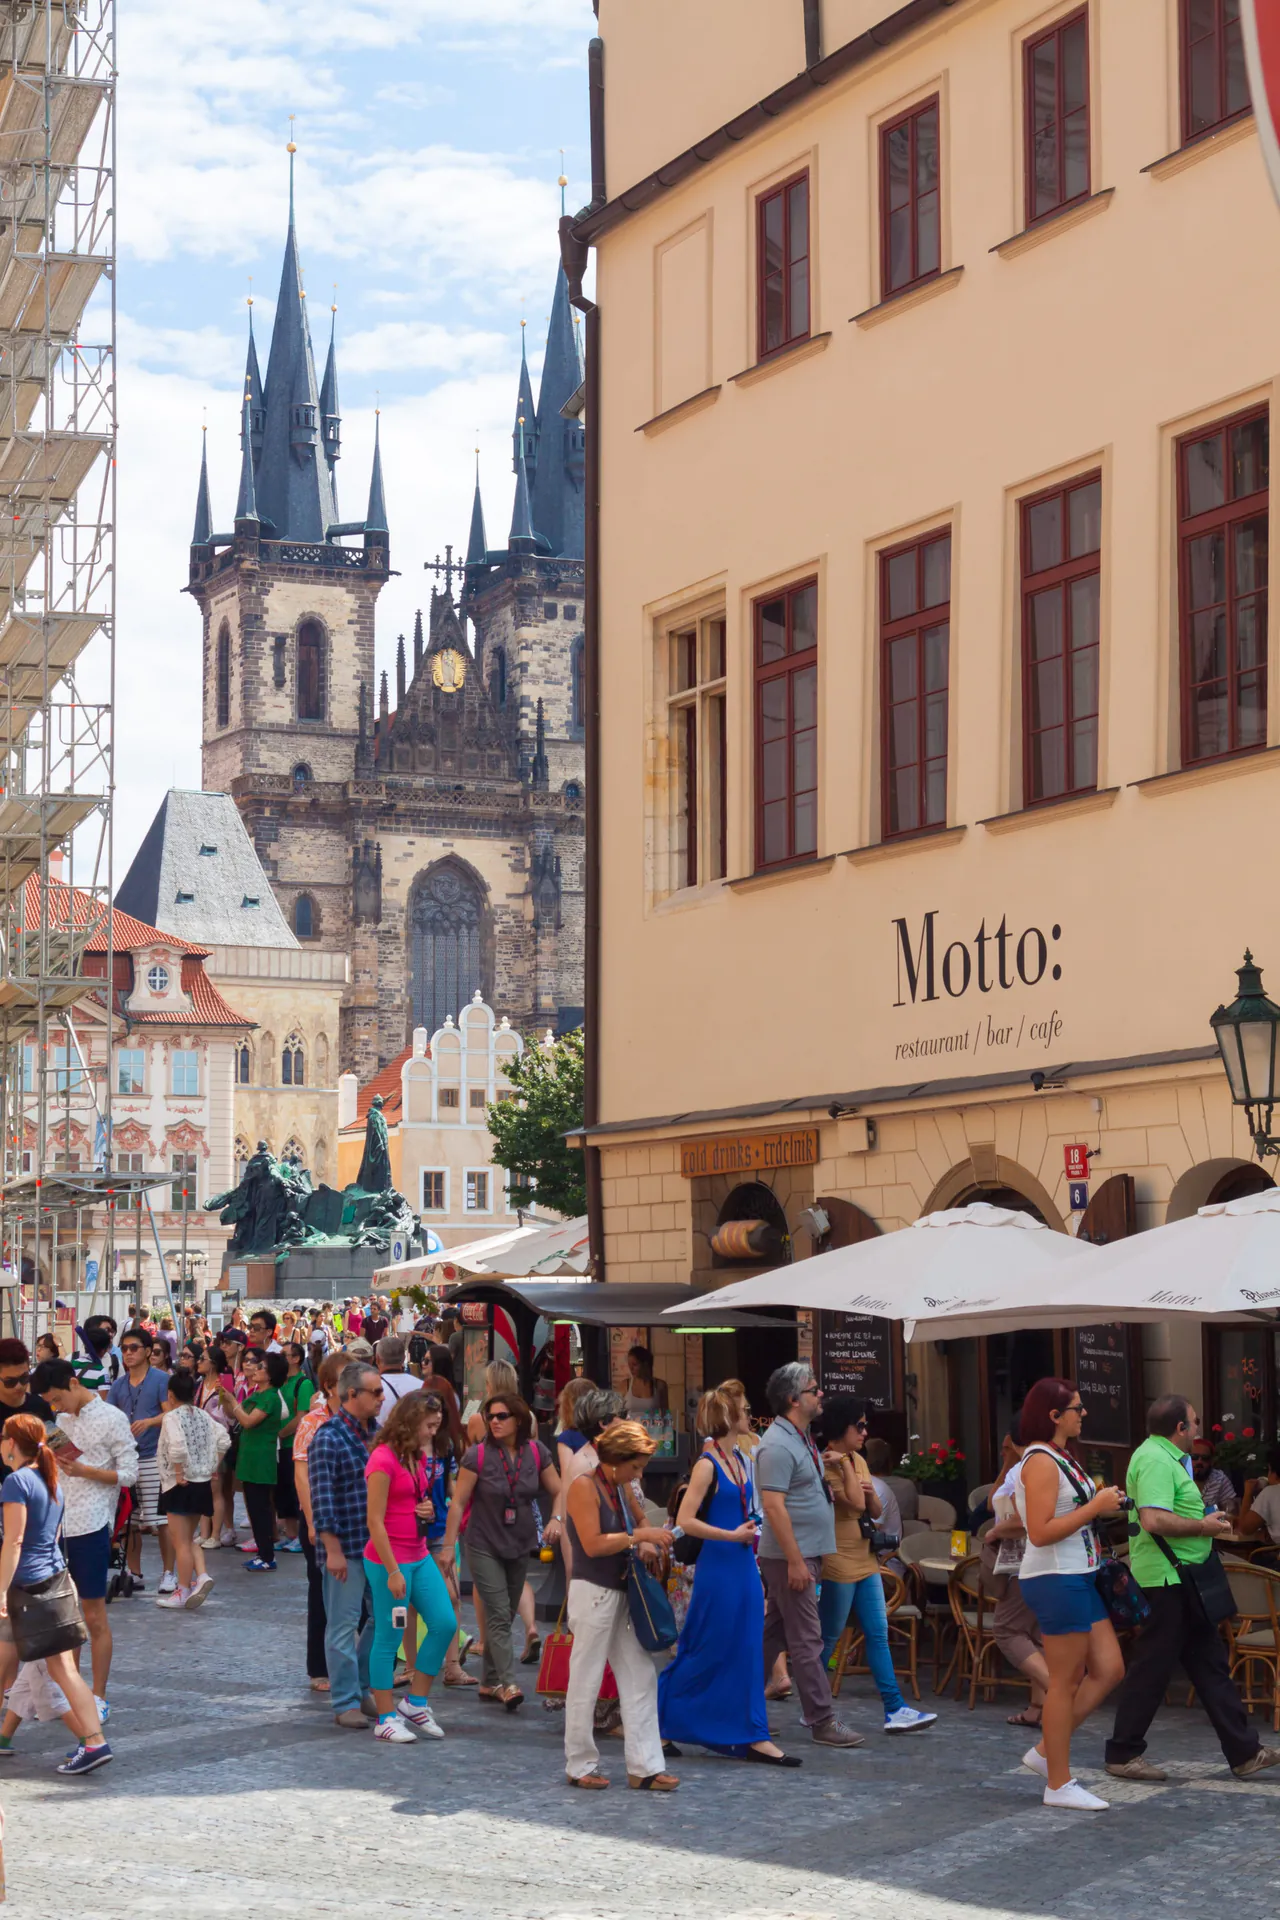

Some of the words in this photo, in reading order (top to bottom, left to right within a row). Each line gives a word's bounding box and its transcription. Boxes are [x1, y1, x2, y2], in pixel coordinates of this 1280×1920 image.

[891, 910, 1062, 1007] Motto:
[895, 1029, 970, 1060] restaurant
[986, 1014, 1013, 1046] bar
[1030, 1009, 1063, 1049] cafe
[683, 1144, 707, 1174] cold
[712, 1140, 752, 1171] drinks
[1070, 1149, 1079, 1163] 18
[1074, 1189, 1081, 1204] 6
